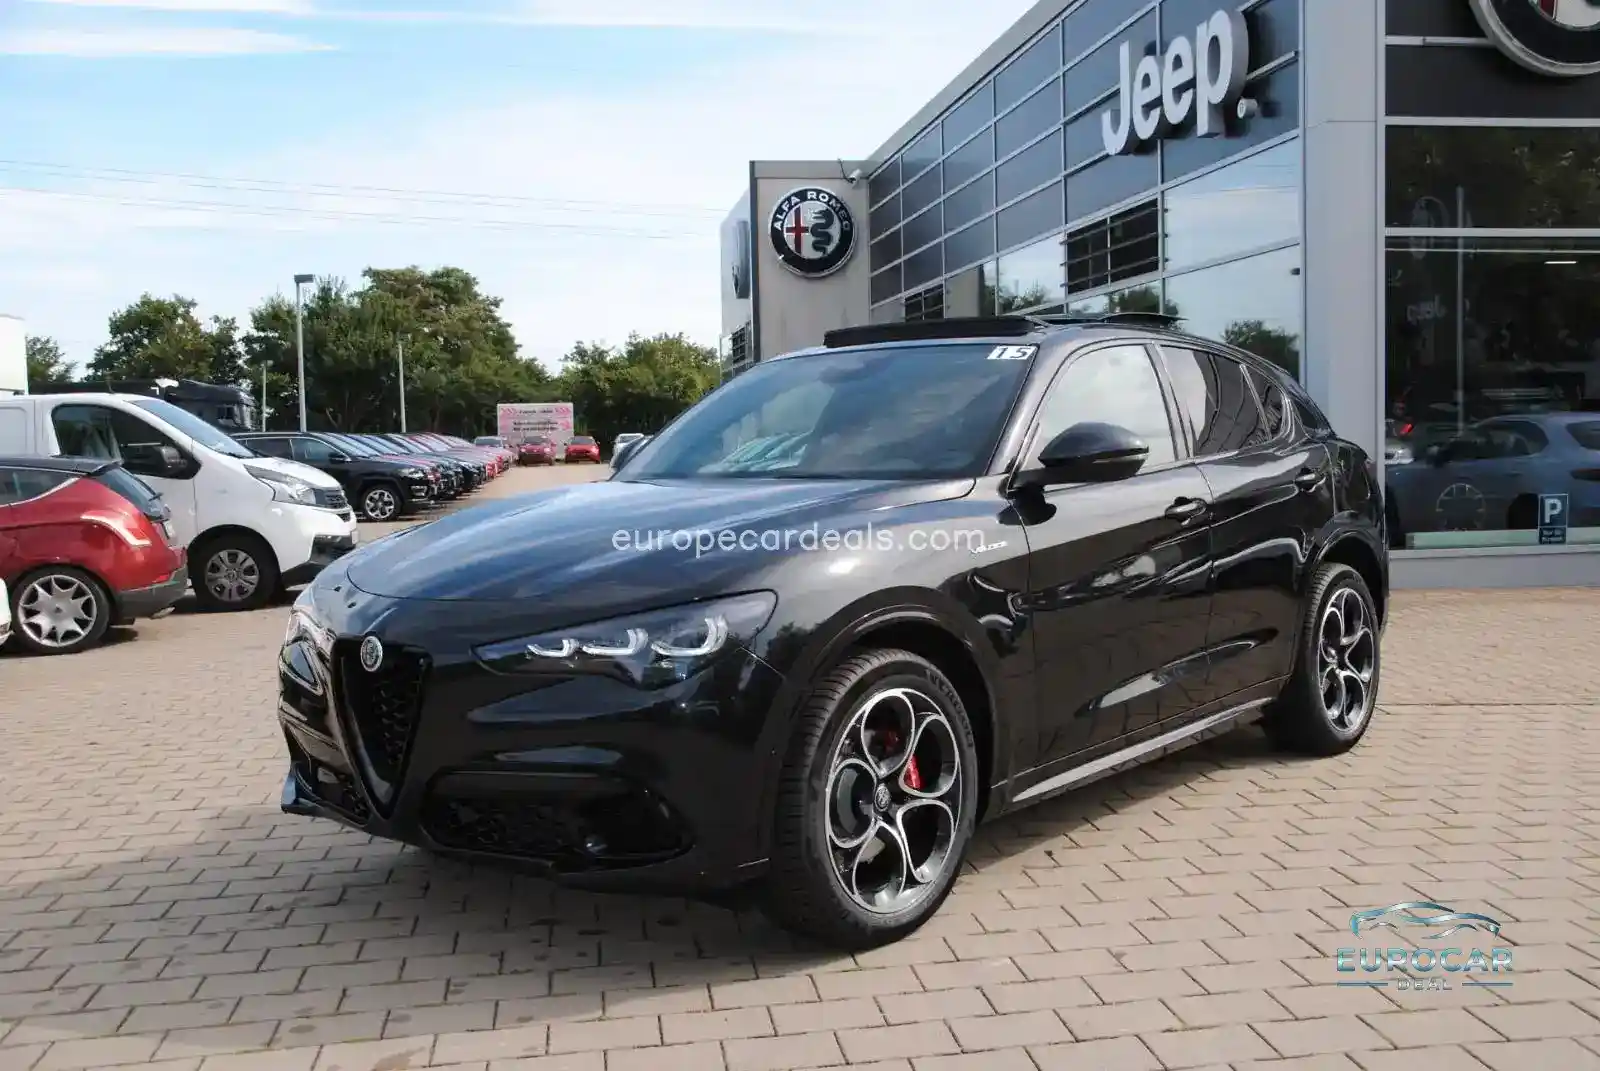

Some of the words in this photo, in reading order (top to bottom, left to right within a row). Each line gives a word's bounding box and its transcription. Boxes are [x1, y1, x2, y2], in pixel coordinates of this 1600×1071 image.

[1102, 10, 1233, 156] Jeep
[773, 196, 801, 231] ALFA
[807, 191, 851, 231] ROMEO
[996, 347, 1031, 359] 15
[1544, 498, 1562, 523] P
